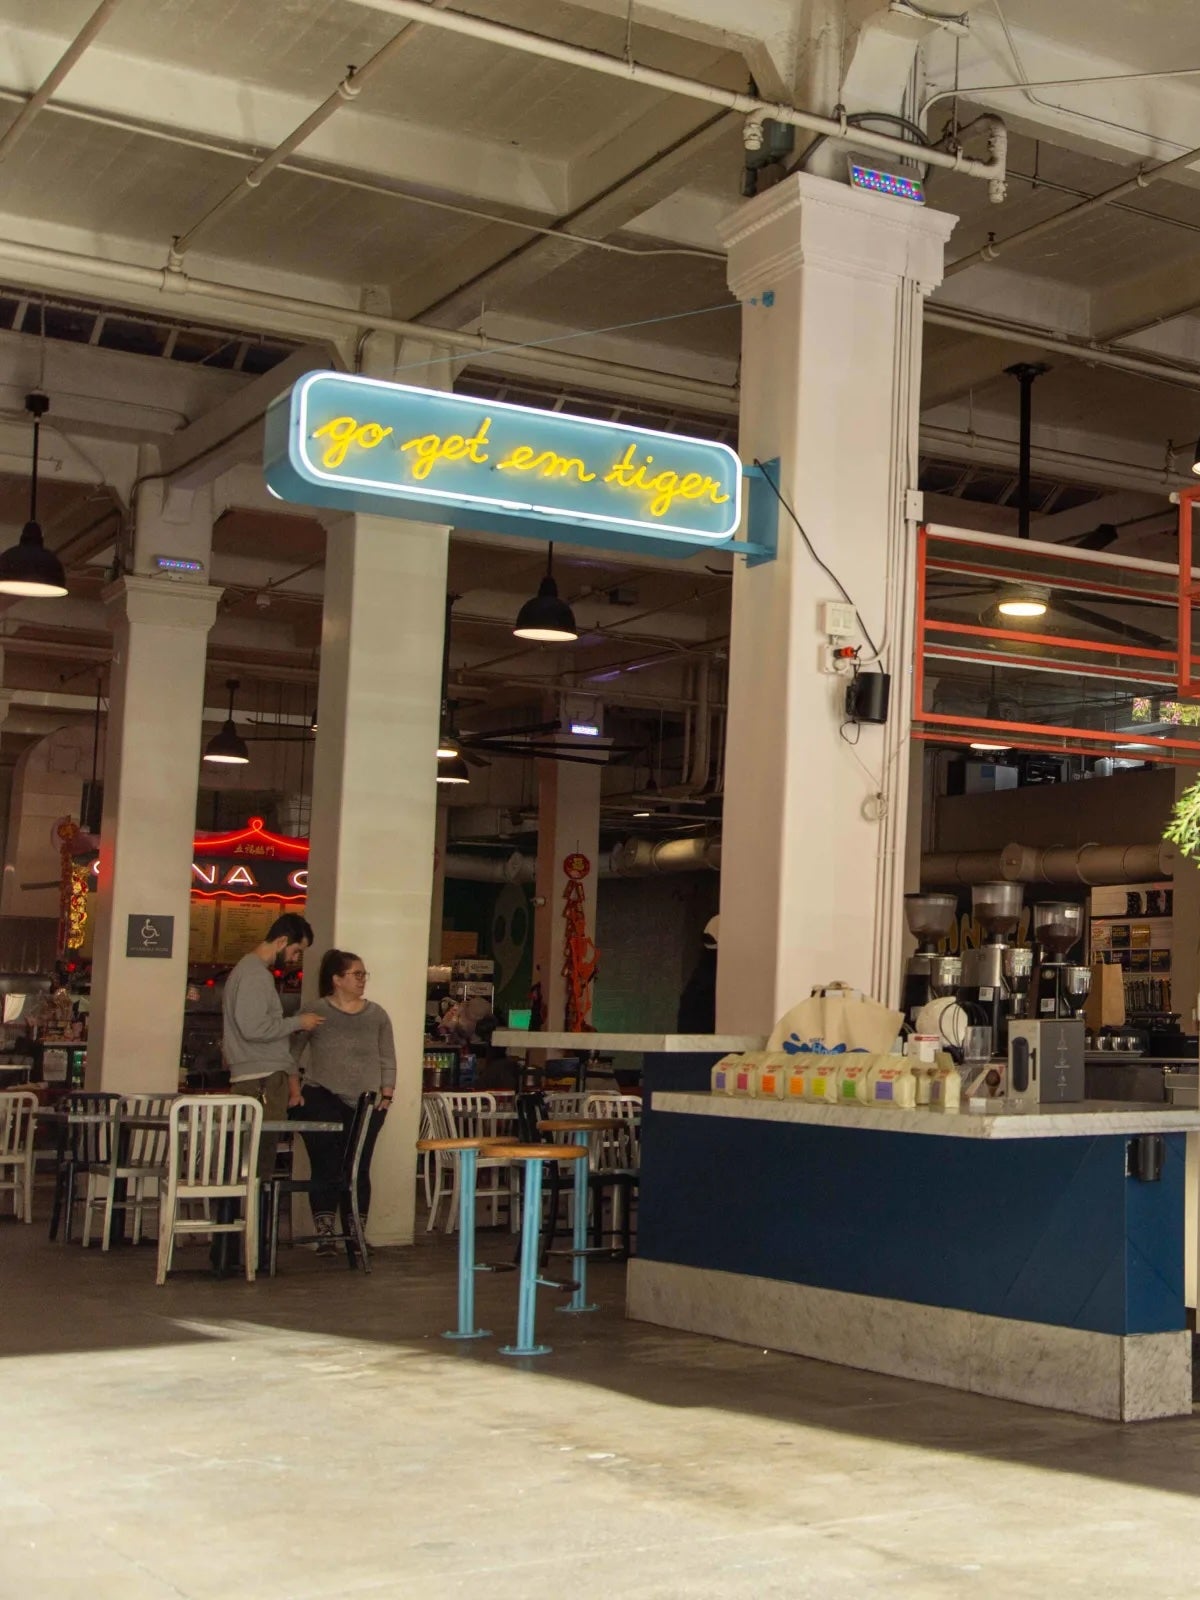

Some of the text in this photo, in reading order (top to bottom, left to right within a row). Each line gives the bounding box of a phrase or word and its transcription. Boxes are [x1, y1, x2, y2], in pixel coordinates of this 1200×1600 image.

[312, 415, 730, 517] go get em tiger
